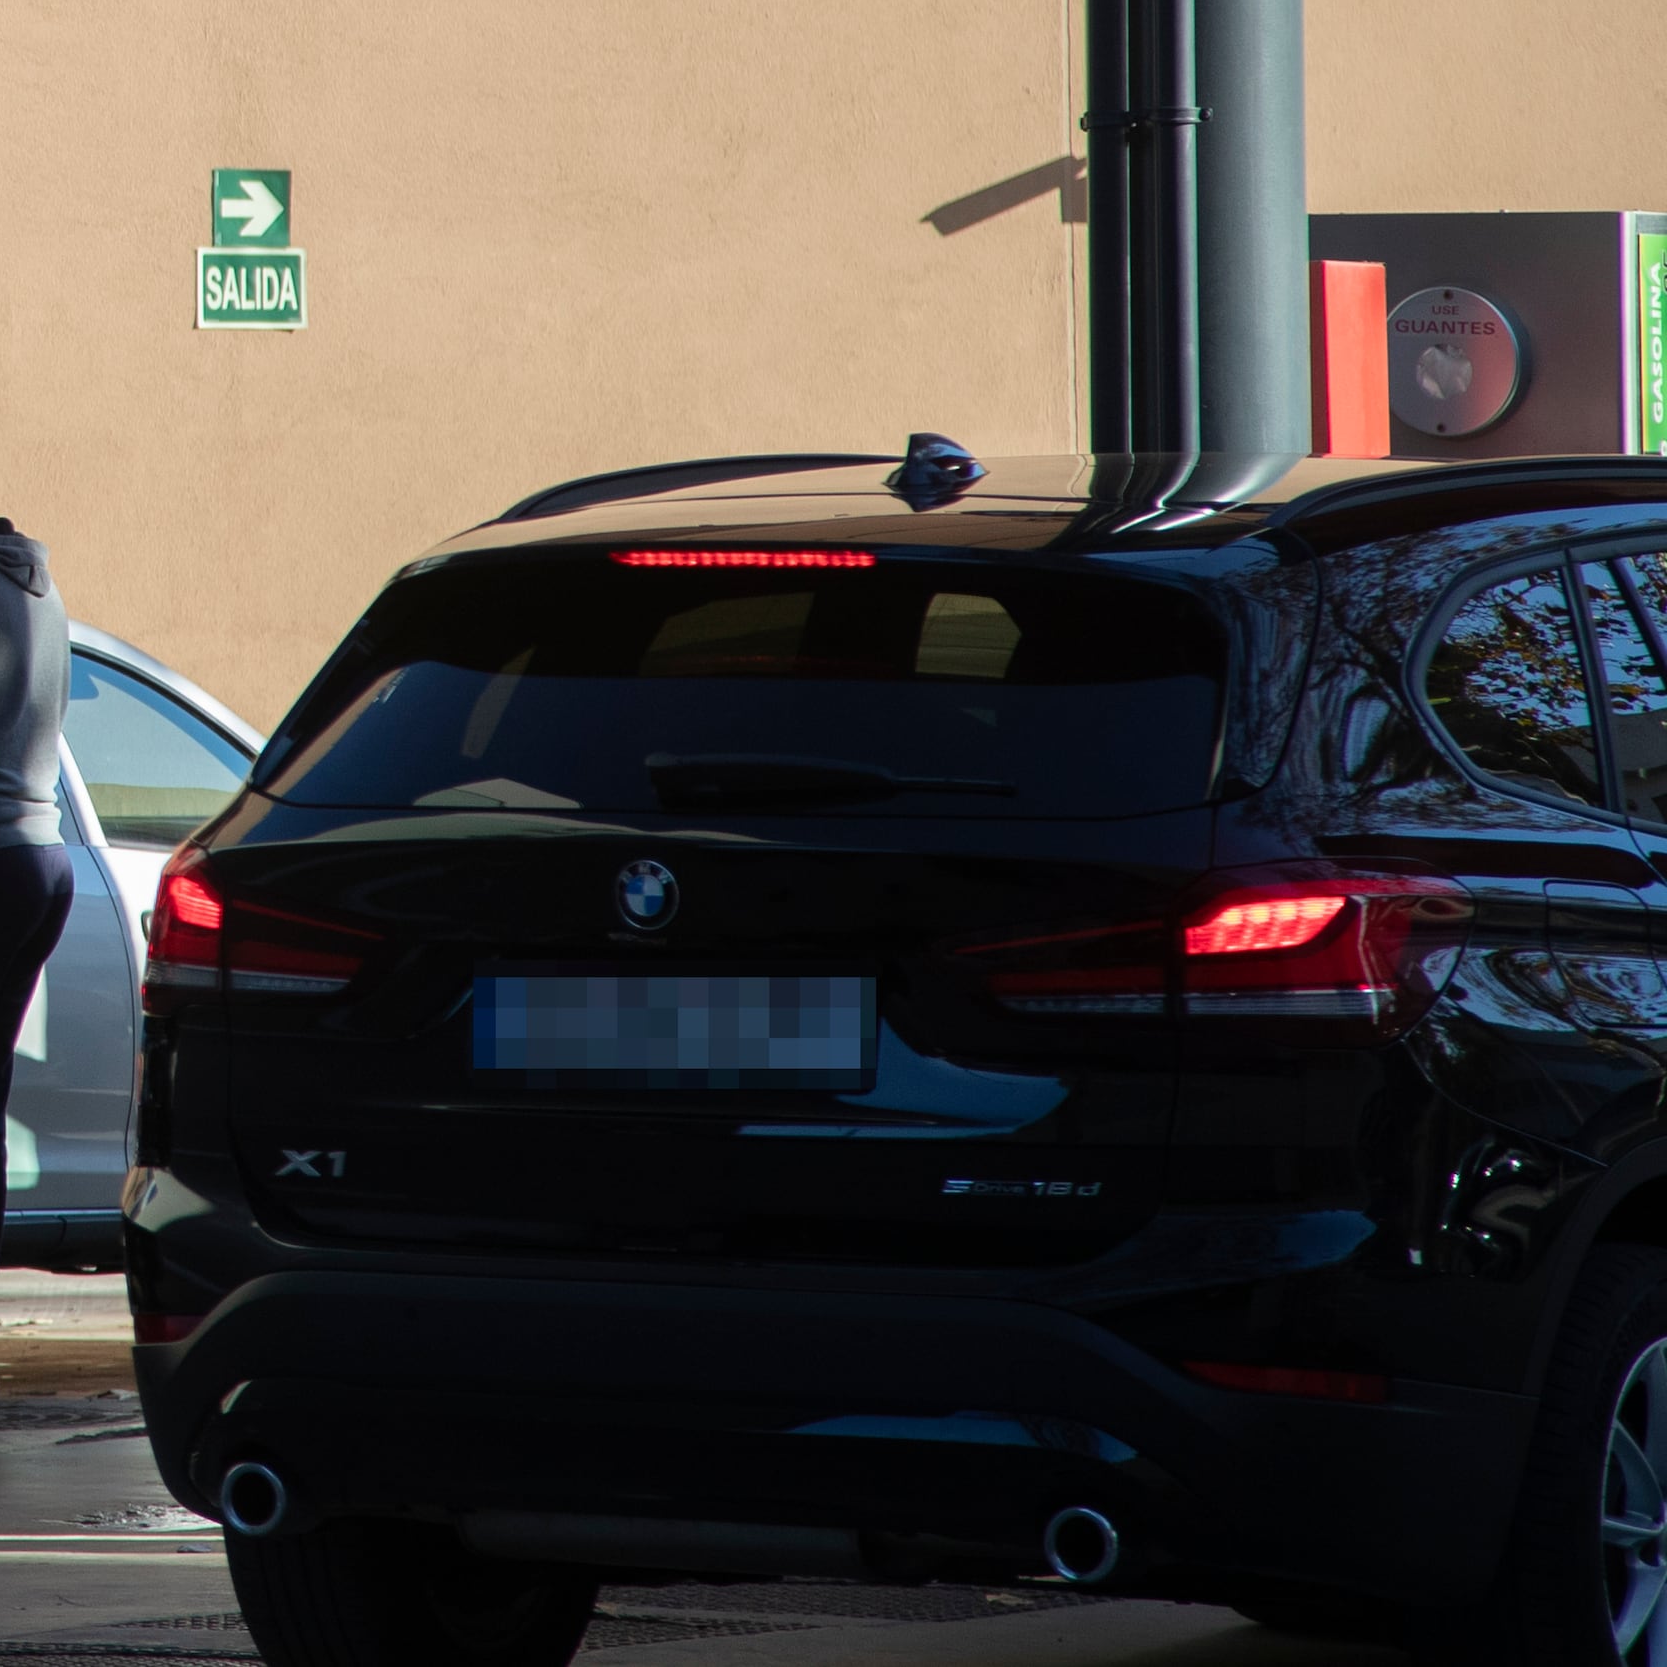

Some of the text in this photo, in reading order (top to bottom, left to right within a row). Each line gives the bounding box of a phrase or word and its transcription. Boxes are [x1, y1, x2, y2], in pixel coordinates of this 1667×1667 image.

[206, 266, 298, 310] SALIDA
[1431, 305, 1459, 316] USE
[1395, 318, 1496, 336] GUANTES
[1648, 262, 1664, 424] GASOLINA
[274, 1149, 347, 1177] X1
